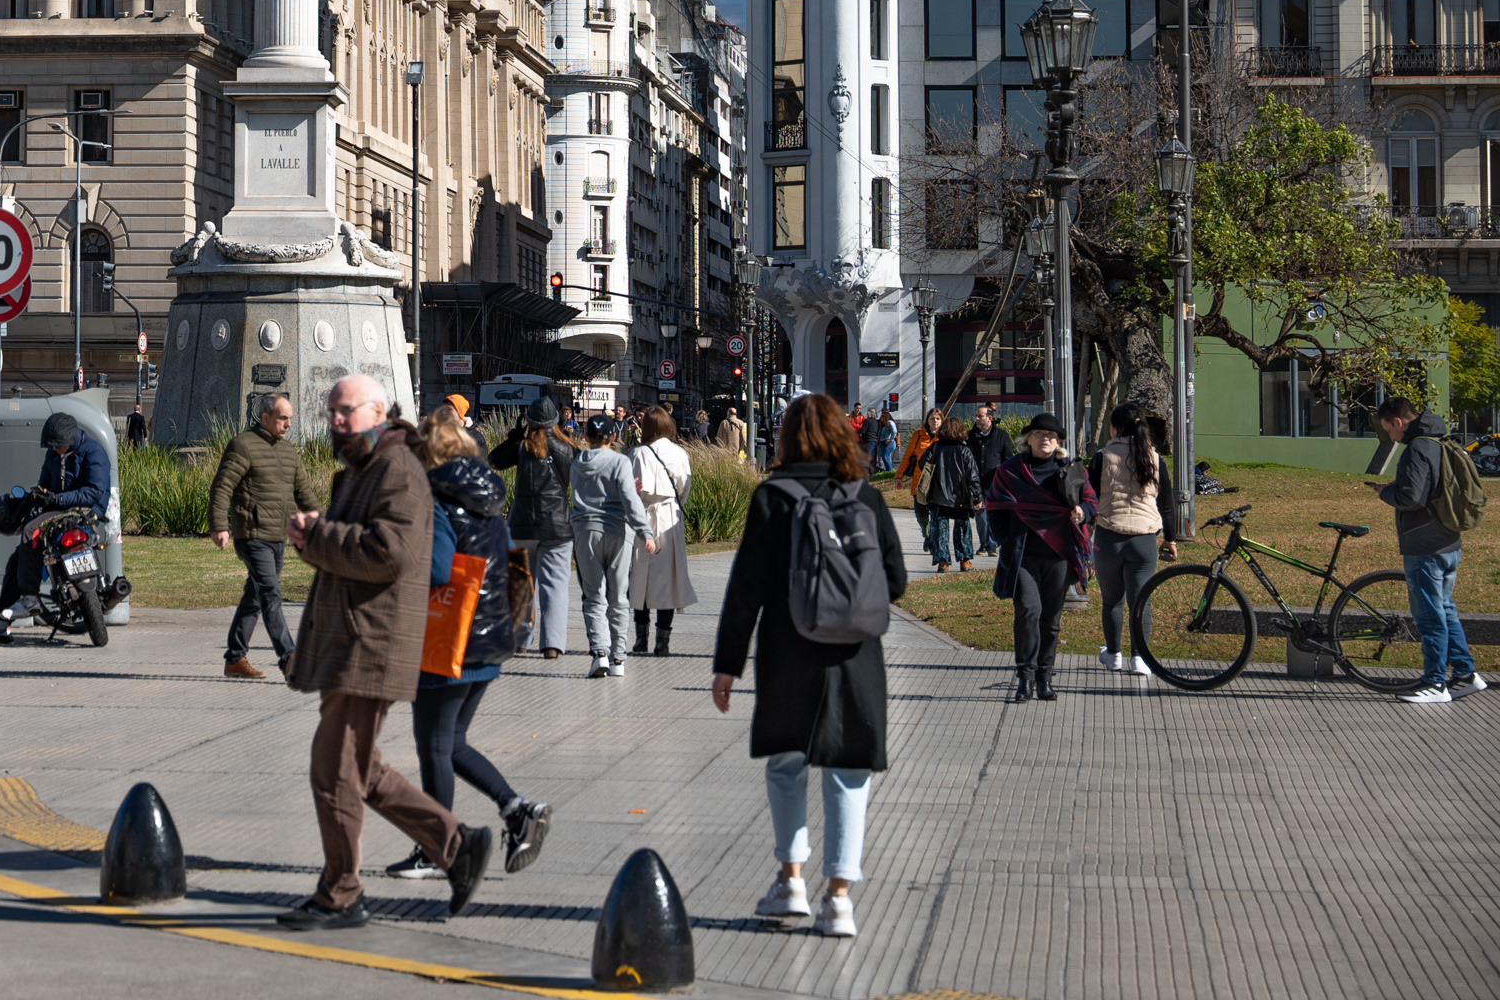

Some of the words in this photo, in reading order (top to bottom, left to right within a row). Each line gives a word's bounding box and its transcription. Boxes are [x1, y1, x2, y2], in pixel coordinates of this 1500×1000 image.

[264, 128, 273, 137] EL
[274, 128, 298, 137] PUEBLO
[278, 143, 283, 152] A
[260, 158, 300, 169] LAVALLE
[731, 341, 742, 350] 20
[664, 363, 671, 375] E
